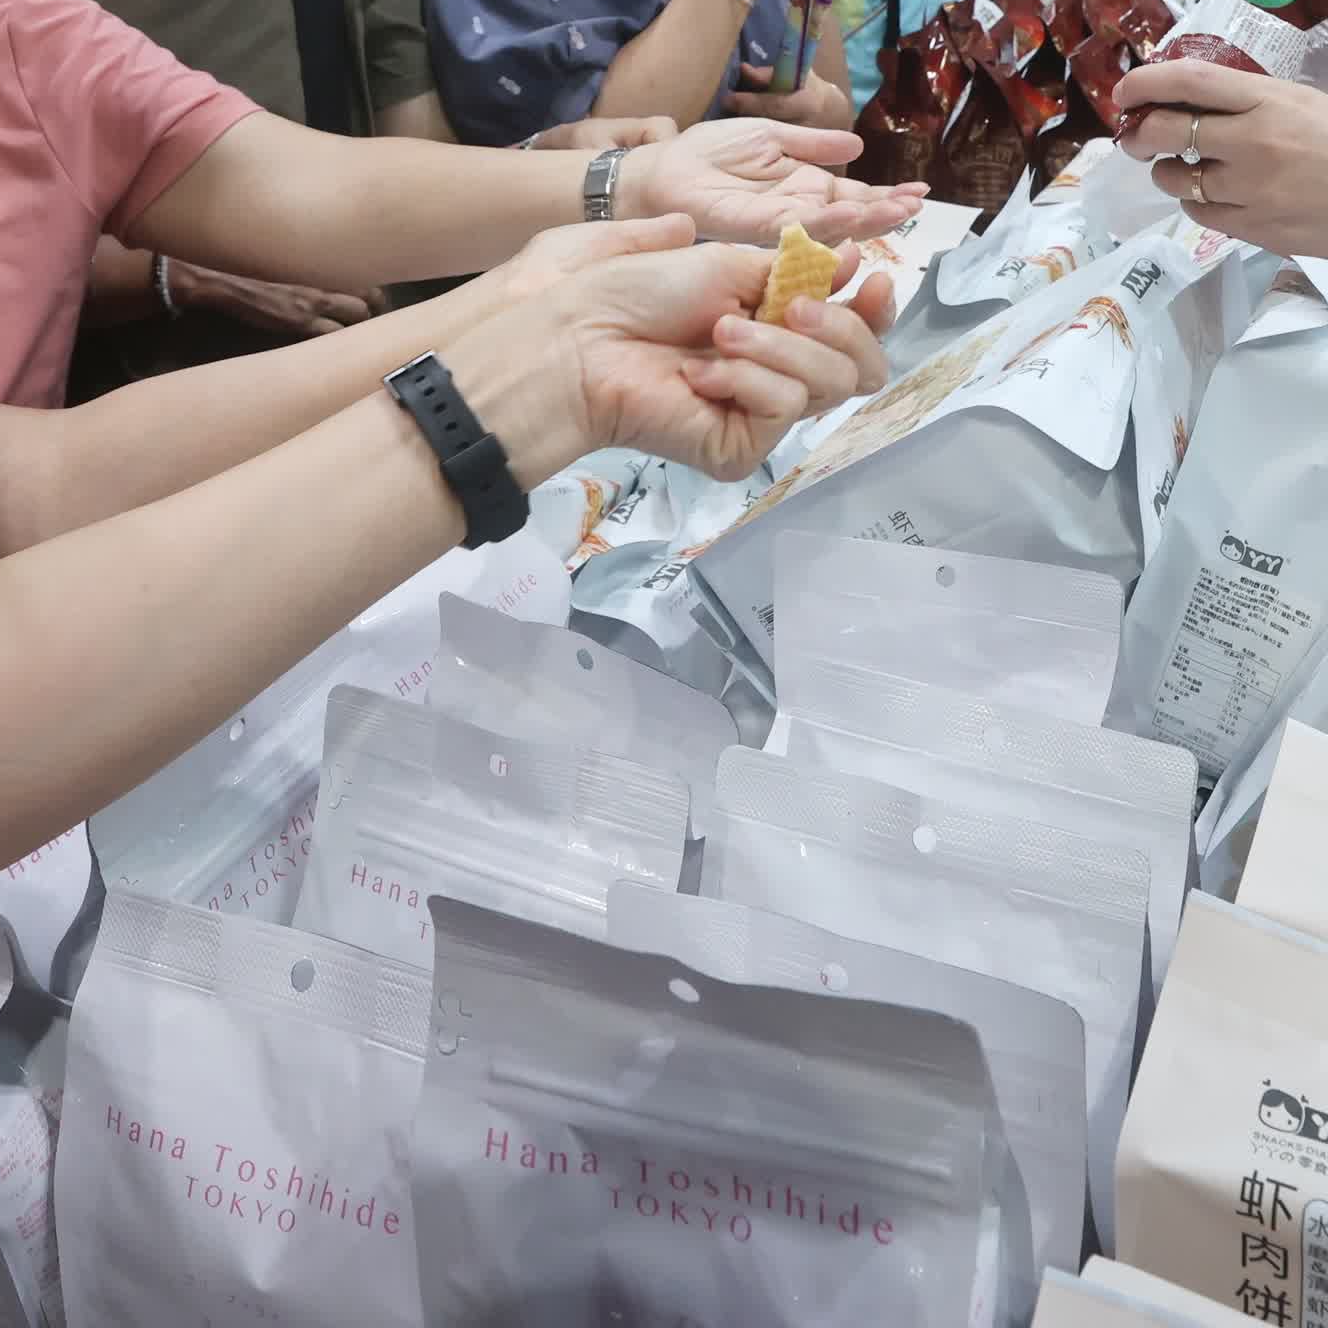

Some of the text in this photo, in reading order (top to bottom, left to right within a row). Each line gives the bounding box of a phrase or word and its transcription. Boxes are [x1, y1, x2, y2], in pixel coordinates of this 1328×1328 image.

[395, 659, 433, 697] Han
[249, 787, 320, 873] Toshi
[351, 863, 419, 909] Hana
[105, 1103, 186, 1163] Hana
[215, 1143, 402, 1236] Toshihide
[186, 1175, 297, 1234] TOKYO
[483, 1127, 895, 1248] Hana Toshihide
[609, 1187, 754, 1244] TOKYO
[1235, 1169, 1299, 1328] 虾肉饼
